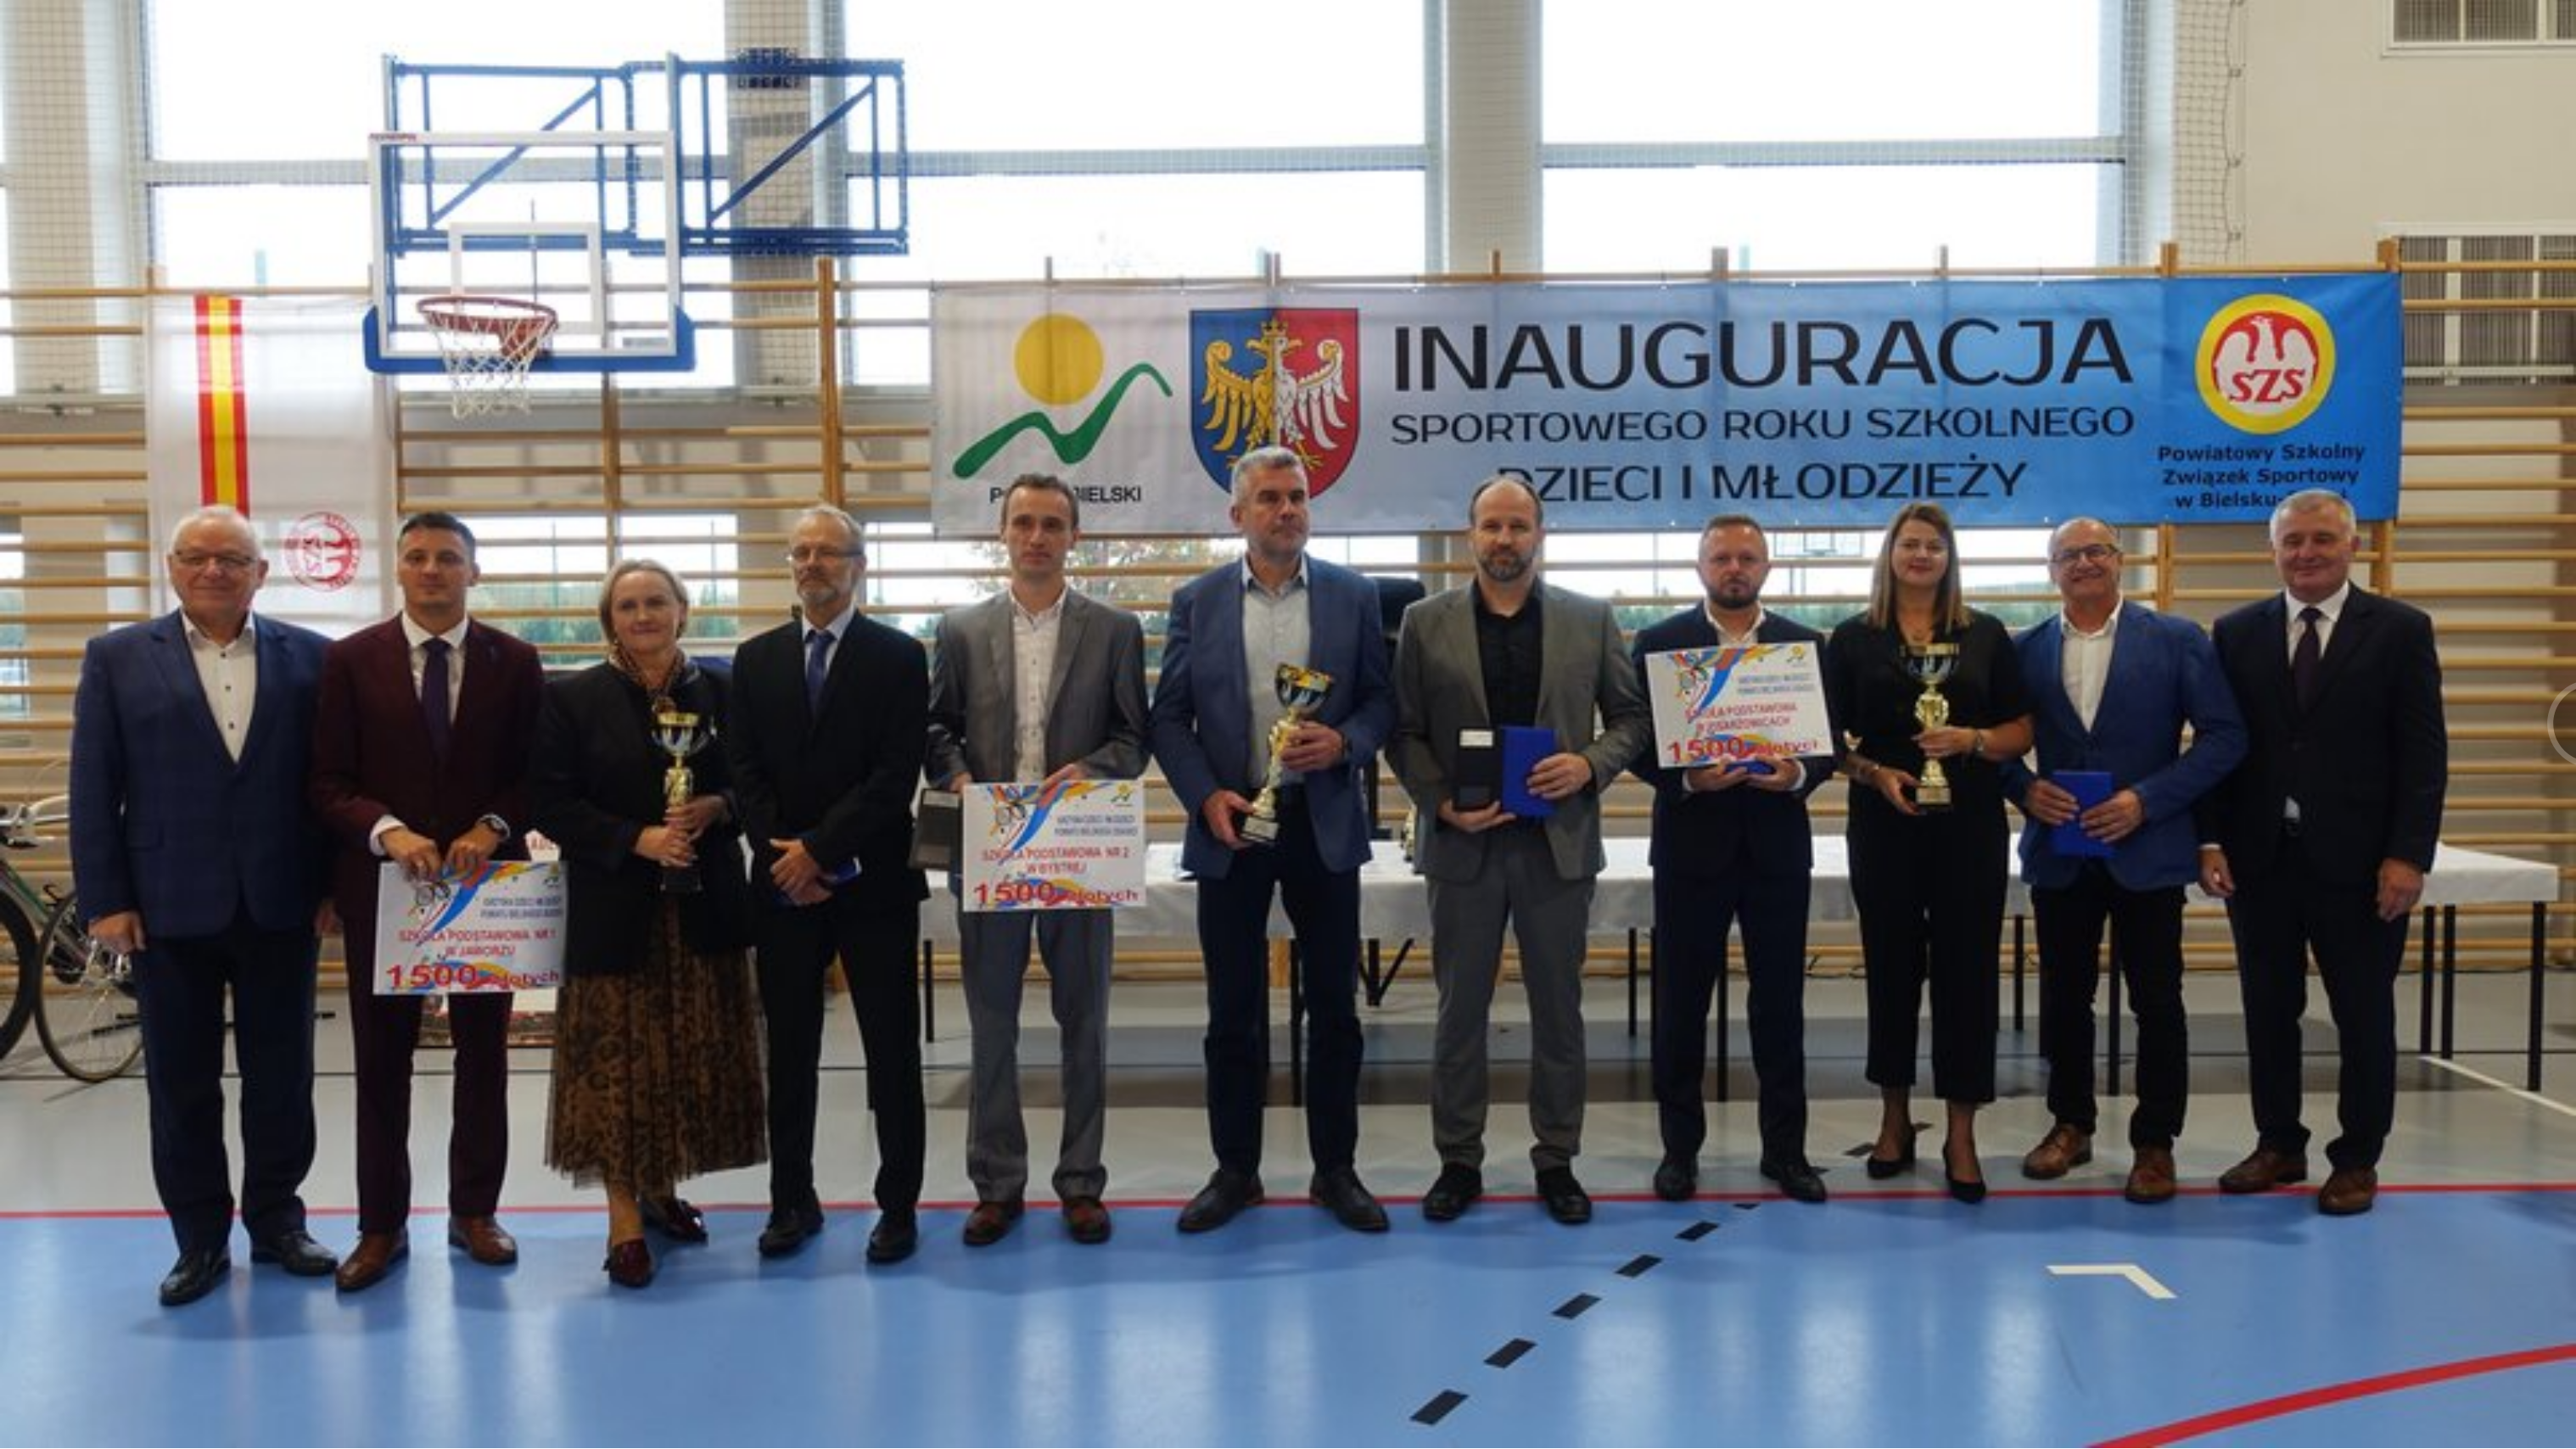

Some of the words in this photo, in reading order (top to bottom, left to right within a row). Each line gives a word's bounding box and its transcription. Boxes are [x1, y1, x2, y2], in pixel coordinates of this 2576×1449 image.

[1396, 318, 2134, 391] INAUGURACJA
[2229, 368, 2306, 403] SZS
[1392, 411, 1707, 445] SPORTOWEGO
[1723, 409, 1851, 440] ROKU
[1867, 406, 2135, 439] SZKOLNEGO
[2158, 445, 2274, 462] Powiatowy
[2282, 443, 2366, 462] Szkolny
[1682, 465, 1691, 501] I
[1712, 452, 2027, 501] MŁODZIEŻY
[2163, 468, 2249, 487] Związek
[2256, 467, 2360, 486] Sportowy
[2175, 495, 2193, 508] w
[1667, 736, 1744, 763] 1500
[974, 881, 1055, 904] 1500
[386, 964, 478, 987] 1500
